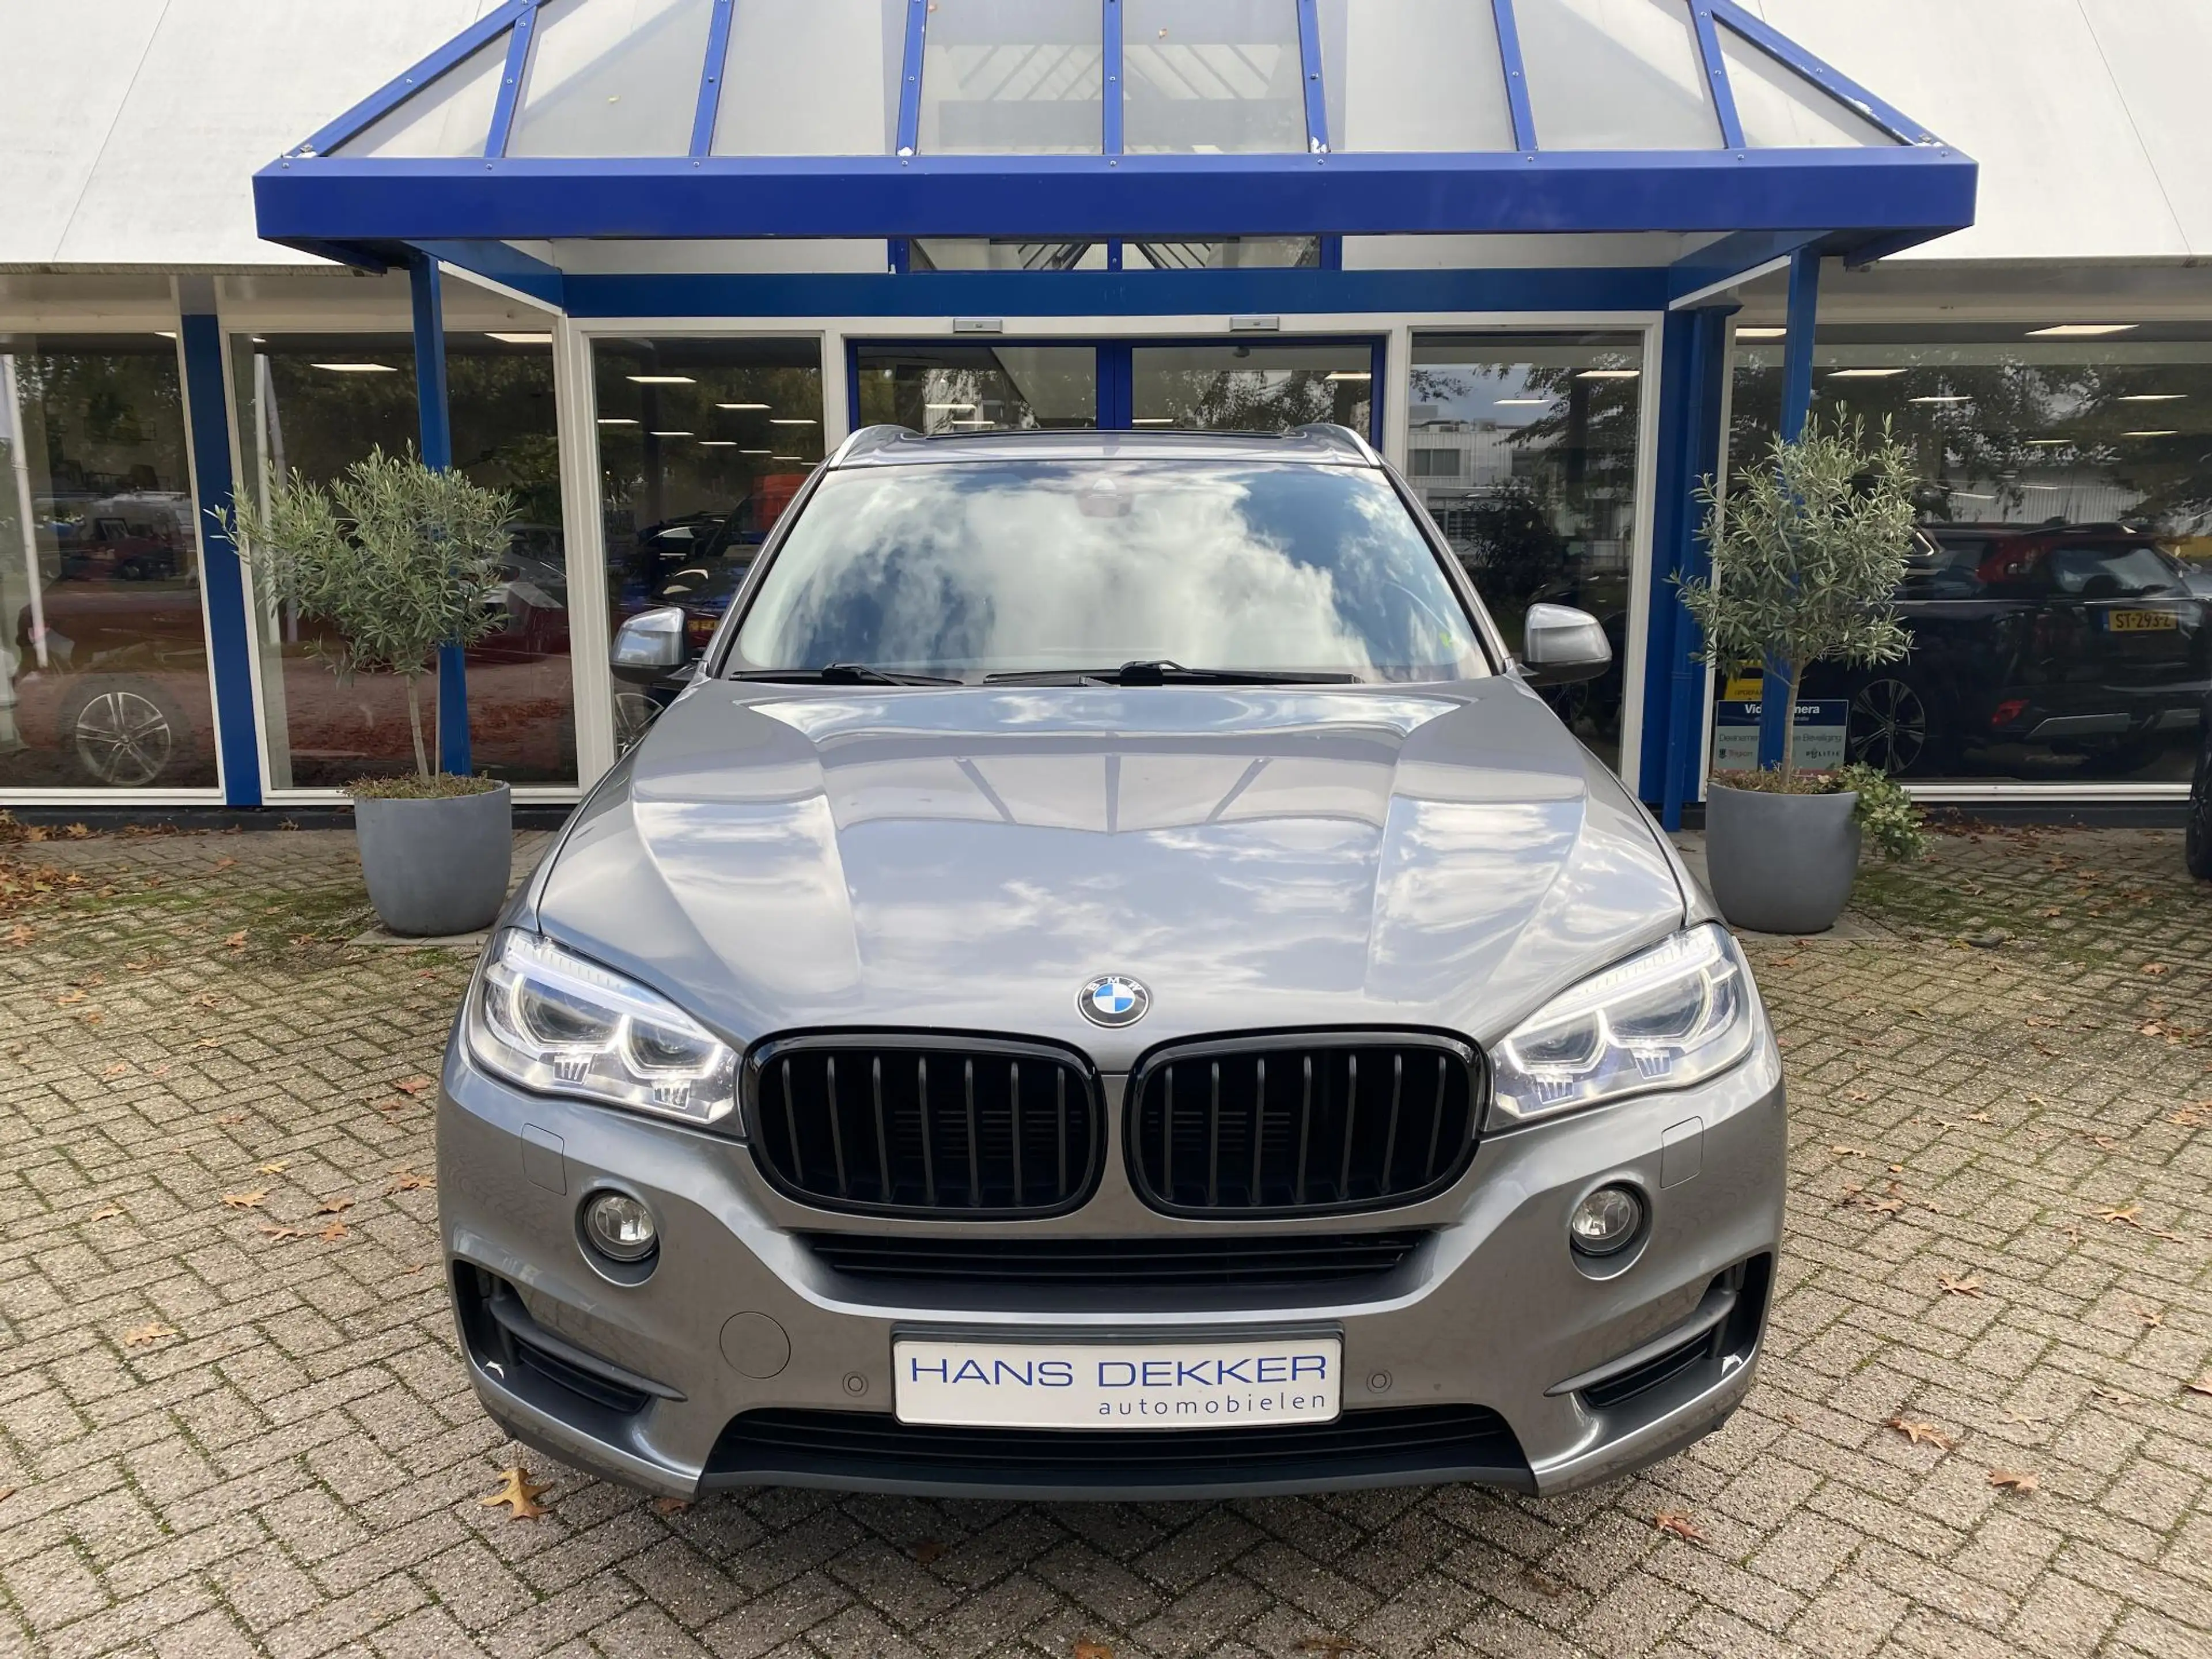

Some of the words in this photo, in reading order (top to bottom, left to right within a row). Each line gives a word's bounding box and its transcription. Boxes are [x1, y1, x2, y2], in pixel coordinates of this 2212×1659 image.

[1086, 976, 1142, 991] BMW
[911, 1357, 1074, 1387] HANS
[1099, 1355, 1327, 1387] DEKKER
[1099, 1392, 1325, 1415] automobielen
